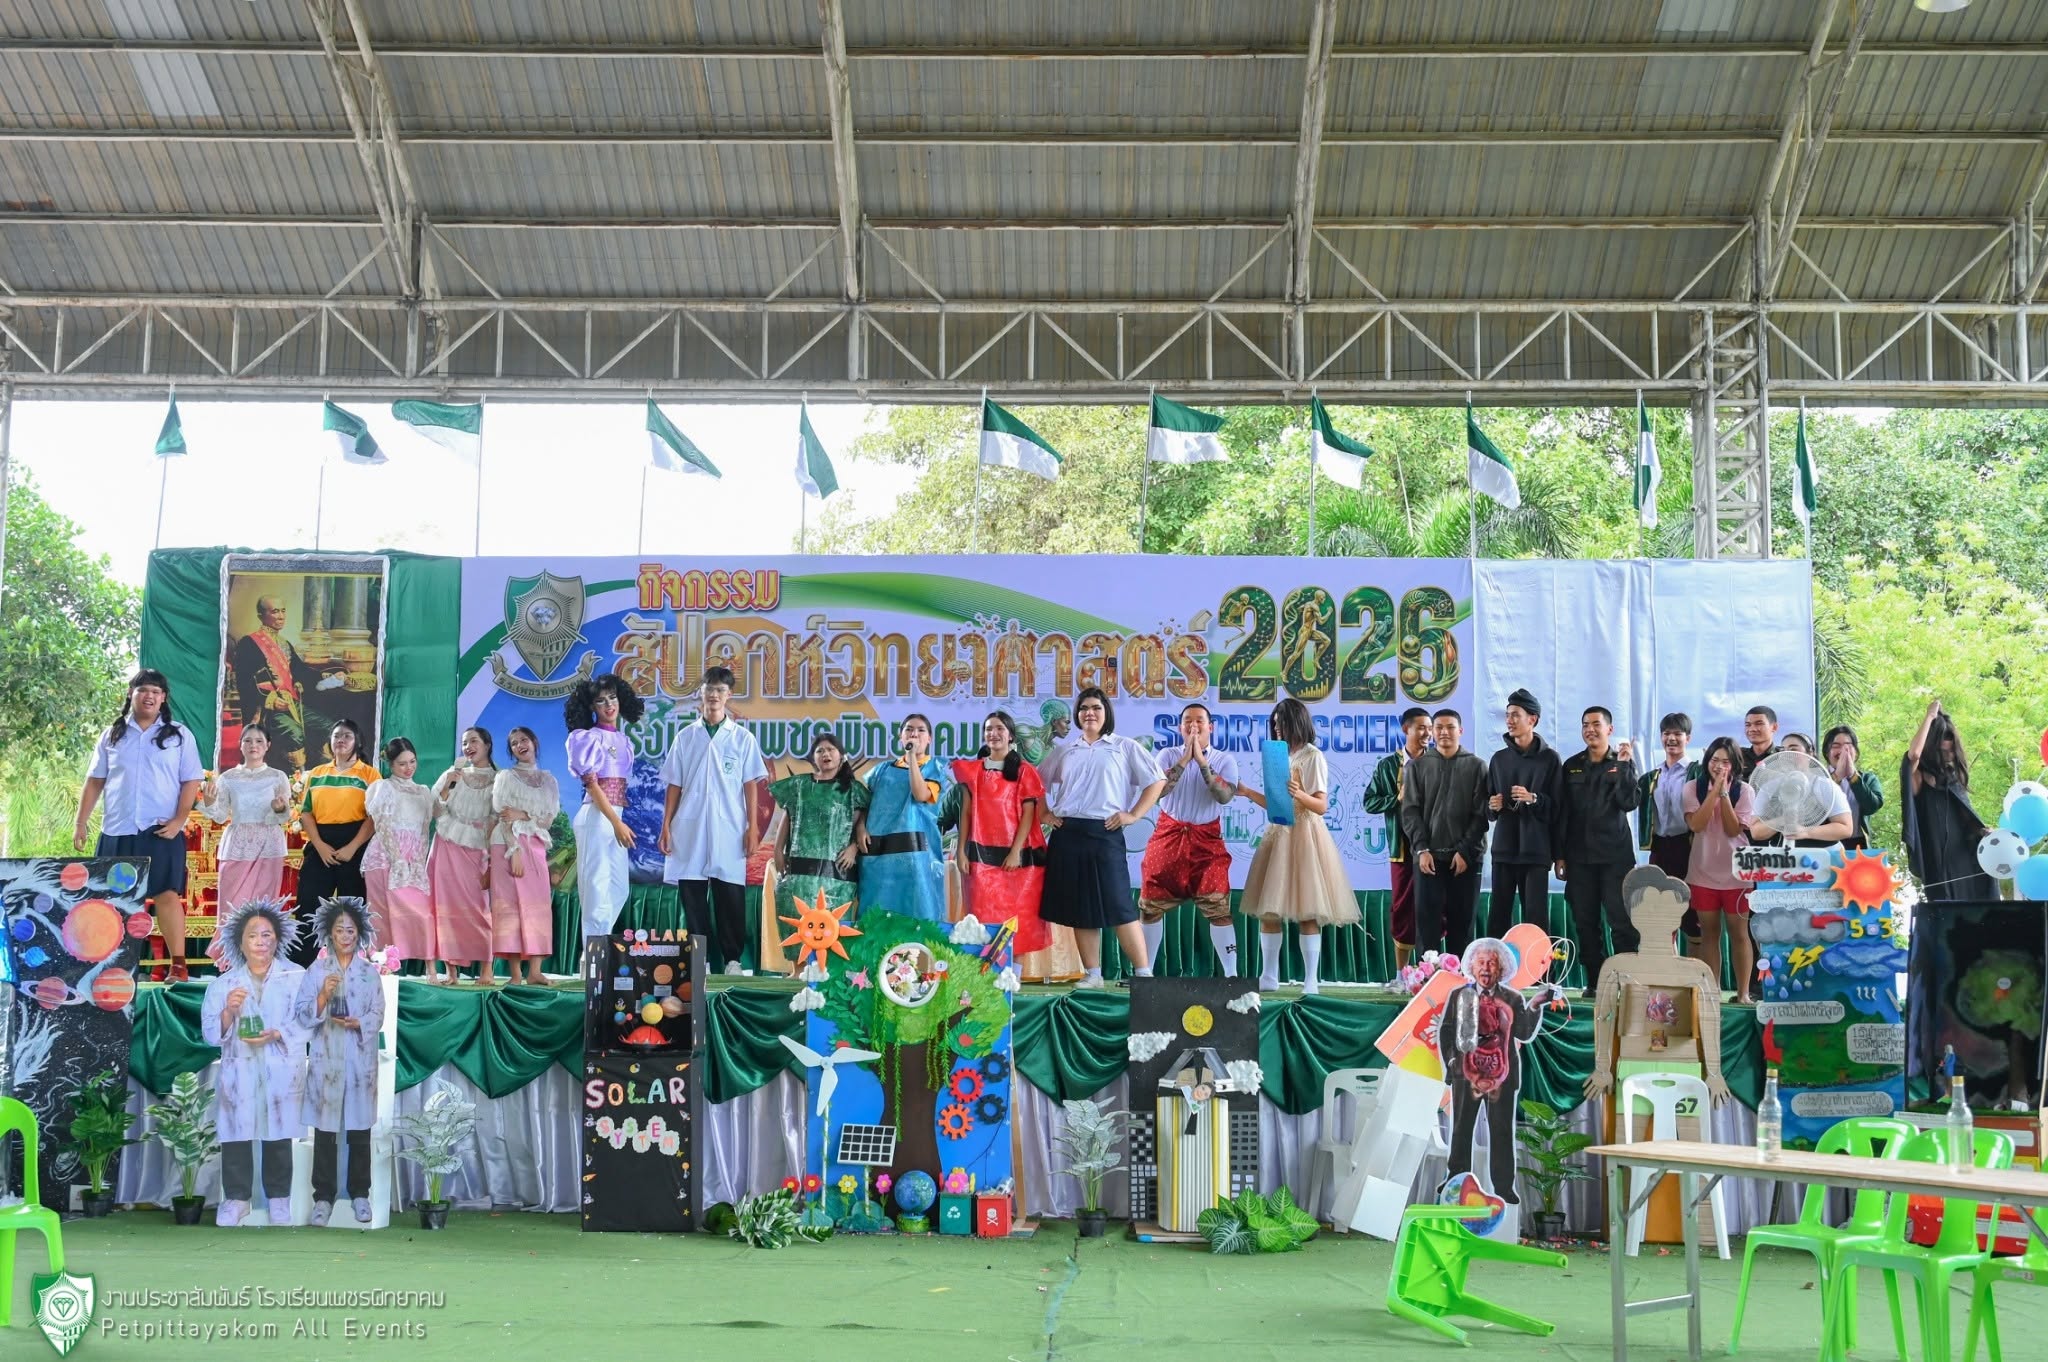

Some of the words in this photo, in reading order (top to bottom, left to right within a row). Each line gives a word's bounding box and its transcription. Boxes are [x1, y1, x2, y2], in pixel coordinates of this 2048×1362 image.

[638, 564, 780, 610] กิจกรรม
[1218, 585, 1460, 704] 2026
[1782, 871, 1815, 886] Cycle
[623, 928, 688, 942] SLAR
[586, 1077, 686, 1109] SOLAR
[599, 1118, 676, 1150] SYSTEM
